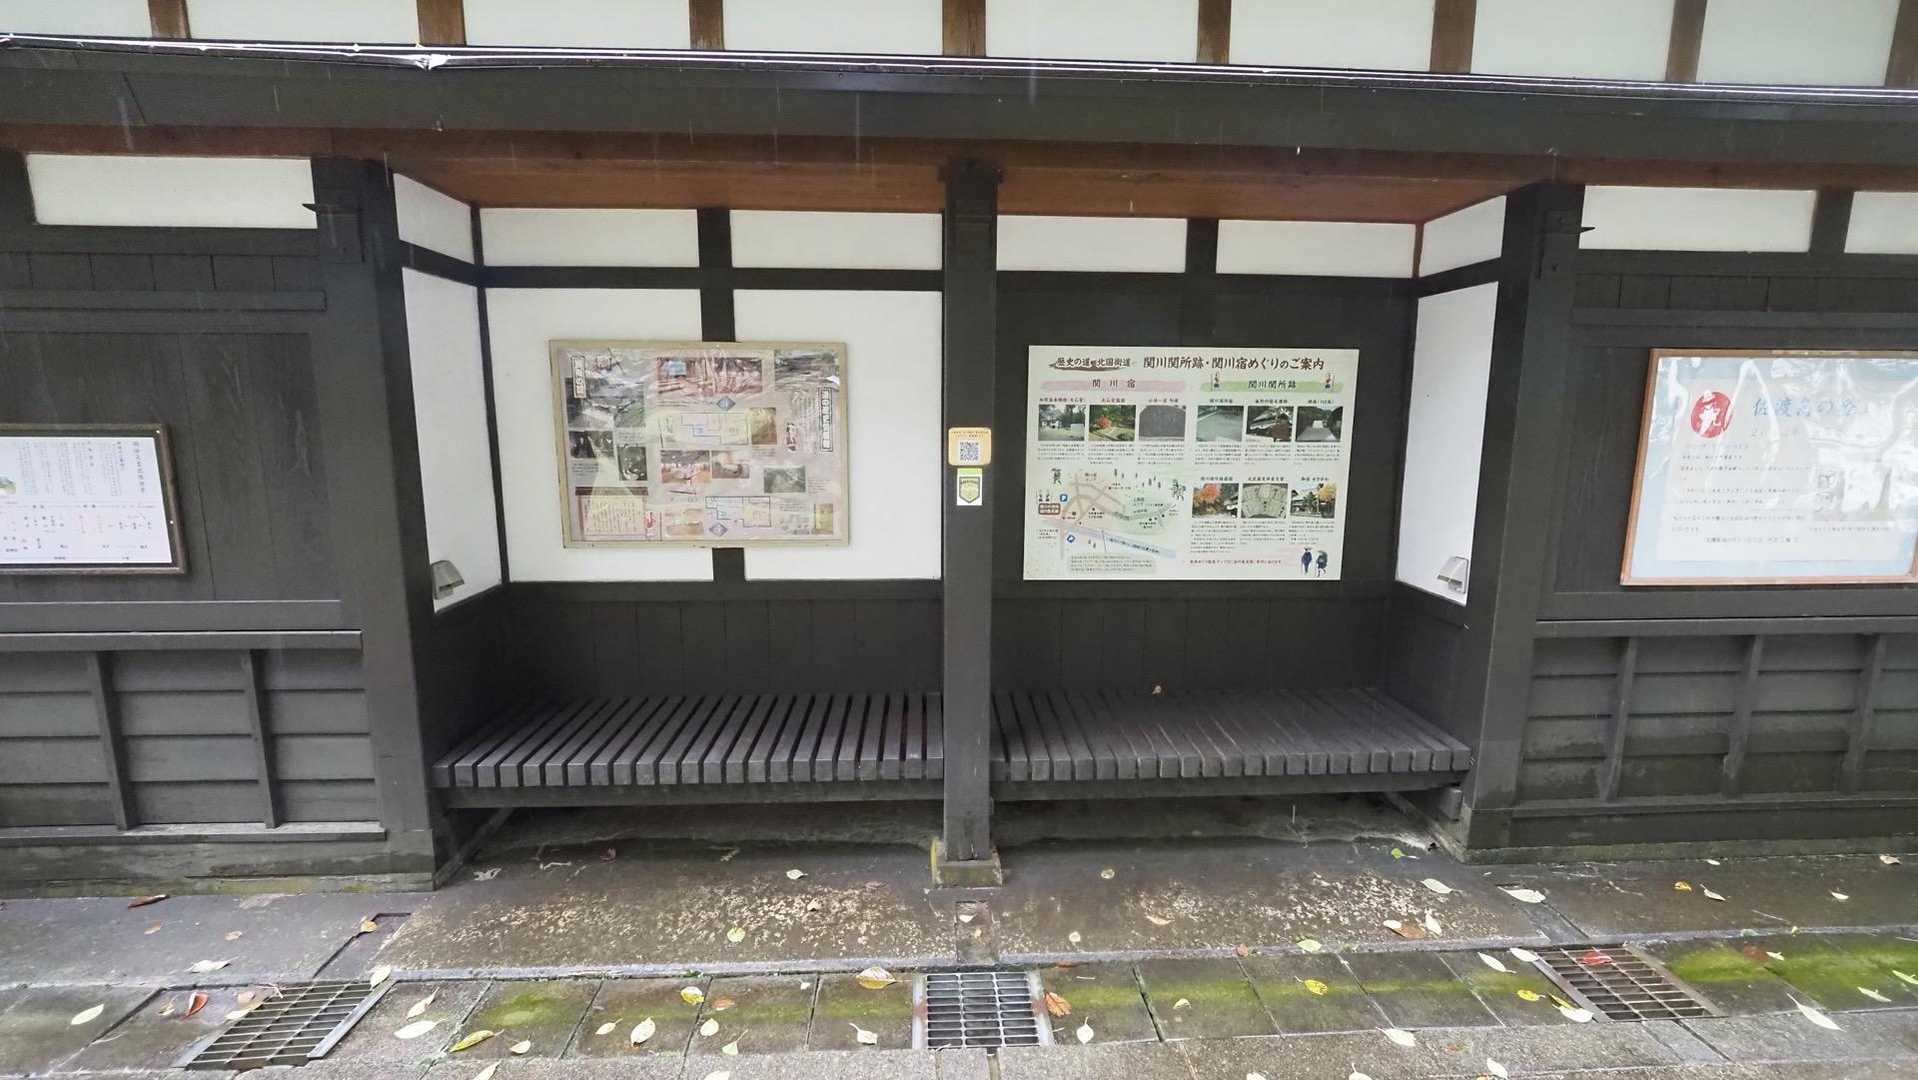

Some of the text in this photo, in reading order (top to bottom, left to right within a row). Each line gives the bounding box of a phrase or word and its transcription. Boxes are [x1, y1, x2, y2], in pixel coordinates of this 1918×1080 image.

[1143, 356, 1325, 370] 関川関所跡・関川宿めぐりのご案内
[1248, 380, 1297, 390] 関川関所跡
